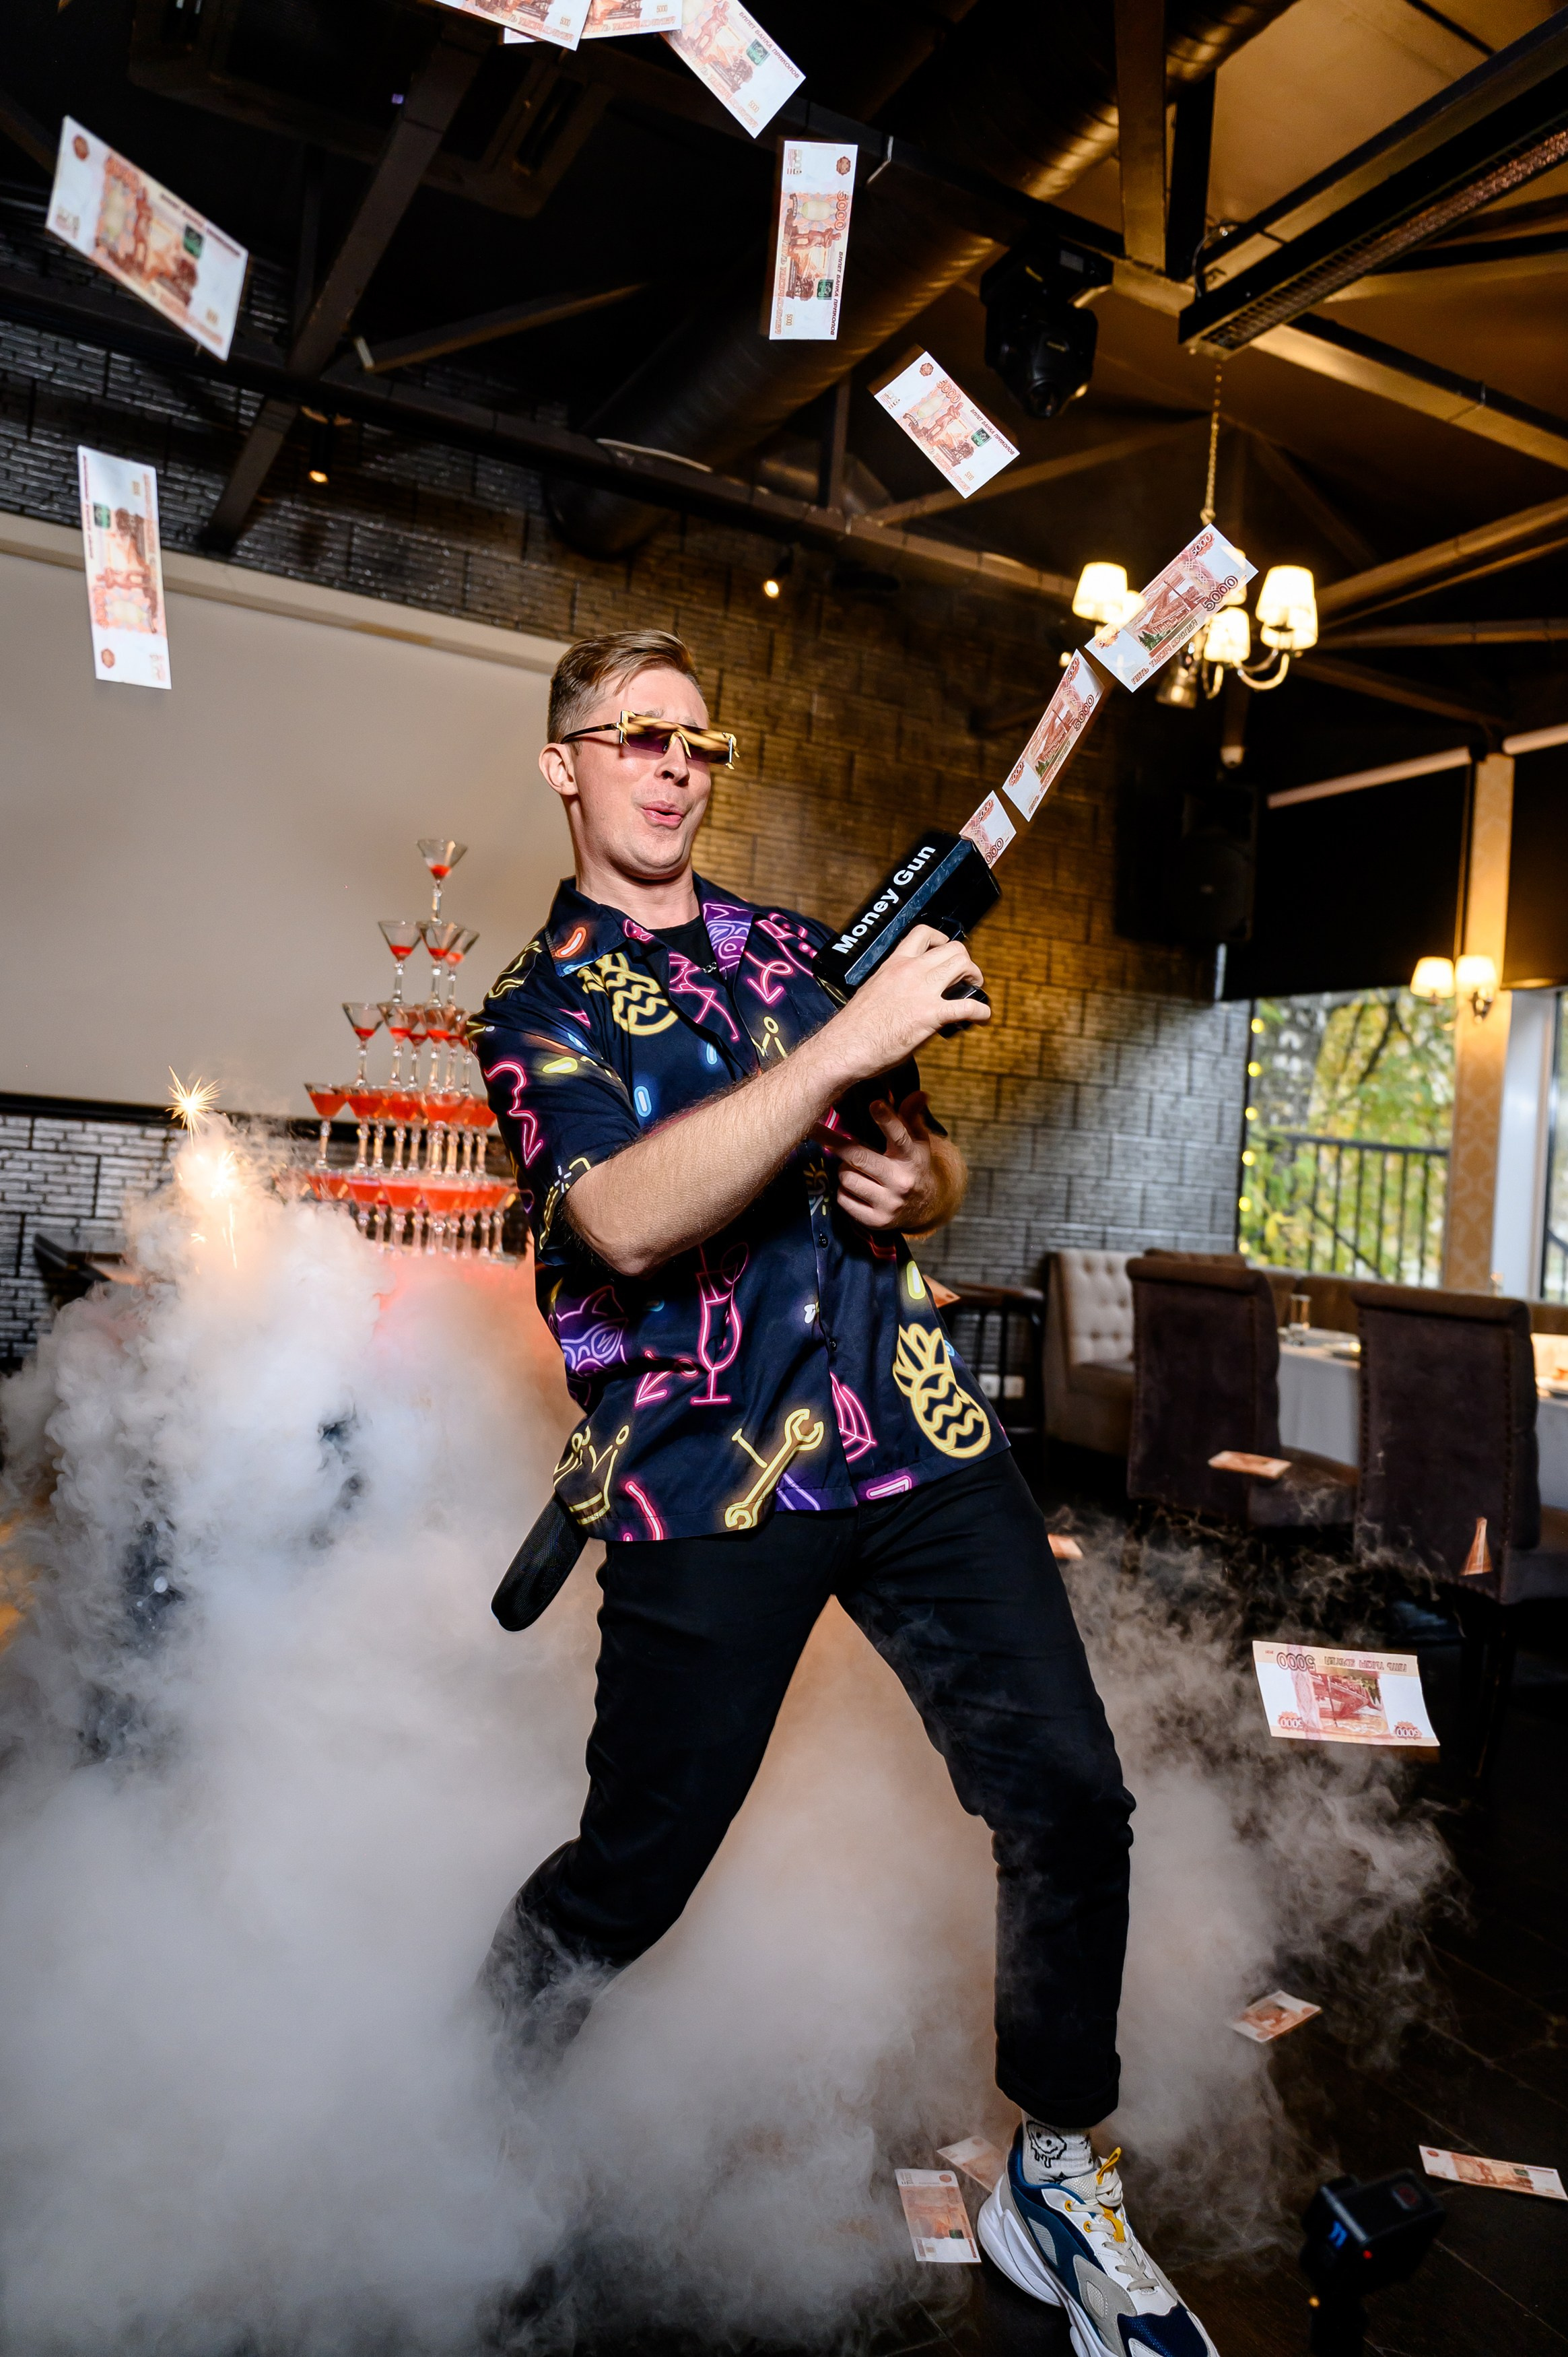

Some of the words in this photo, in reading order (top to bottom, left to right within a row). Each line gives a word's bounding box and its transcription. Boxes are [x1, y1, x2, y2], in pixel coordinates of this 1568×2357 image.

[656, 5, 668, 13] 5000
[739, 11, 755, 29] БИЛЕТ
[755, 29, 773, 48] БАНКА
[772, 48, 800, 79] ПРИКОЛОВ
[748, 100, 759, 113] 5000
[834, 190, 848, 231] 5000
[830, 298, 838, 335] ПРИКОЛОВ
[936, 378, 961, 404] 5000
[970, 409, 983, 422] БИЛЕТ
[982, 421, 995, 434] БАНКА
[993, 434, 1015, 455] ПРИКОЛОВ
[965, 471, 974, 481] 5000
[1191, 533, 1212, 556] 5000
[1202, 575, 1238, 611] 5000
[1067, 657, 1079, 682] 5000
[1131, 667, 1149, 685] ПЯТЬ
[1149, 644, 1172, 667] ТЫСЯЧ
[1073, 694, 1094, 731] 5000
[1009, 762, 1024, 785] 5000
[977, 800, 993, 822] 5000
[984, 837, 1004, 864] 000
[831, 888, 899, 954] Money
[893, 846, 936, 886] Gun
[1276, 1652, 1316, 1673] 5000
